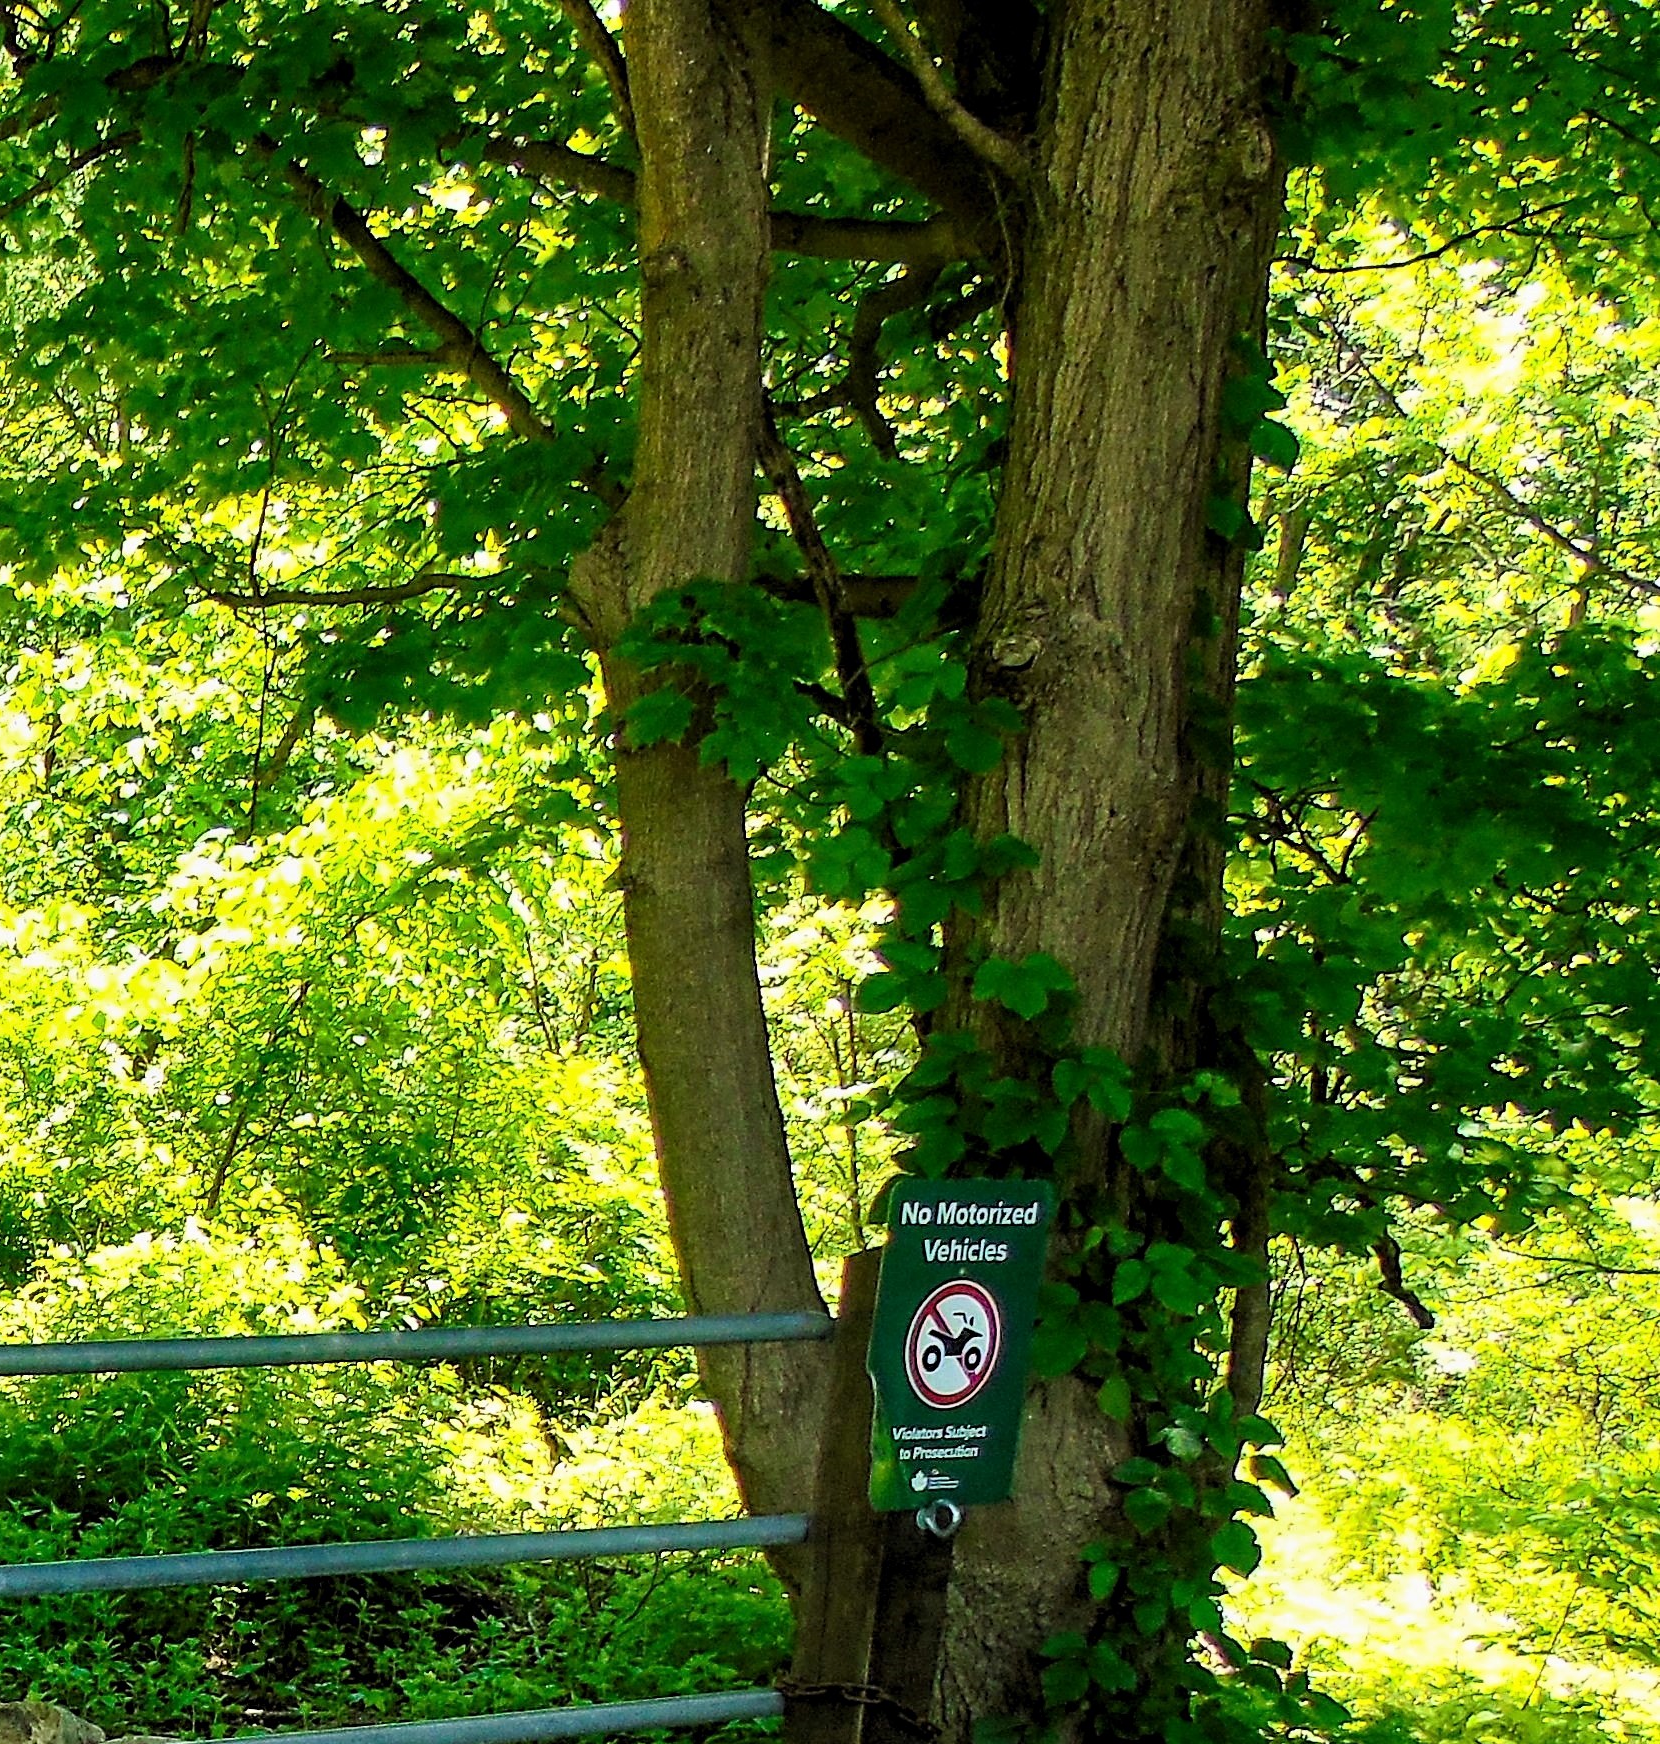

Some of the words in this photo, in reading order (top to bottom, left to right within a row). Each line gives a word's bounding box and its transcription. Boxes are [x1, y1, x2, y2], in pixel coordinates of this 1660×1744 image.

[901, 1202, 931, 1225] No
[936, 1201, 1038, 1225] Motorized
[924, 1238, 1008, 1262] Vehicles
[892, 1427, 943, 1440] Violators
[944, 1425, 987, 1440] Subject
[899, 1448, 911, 1460] to
[912, 1445, 979, 1460] Prosecution
